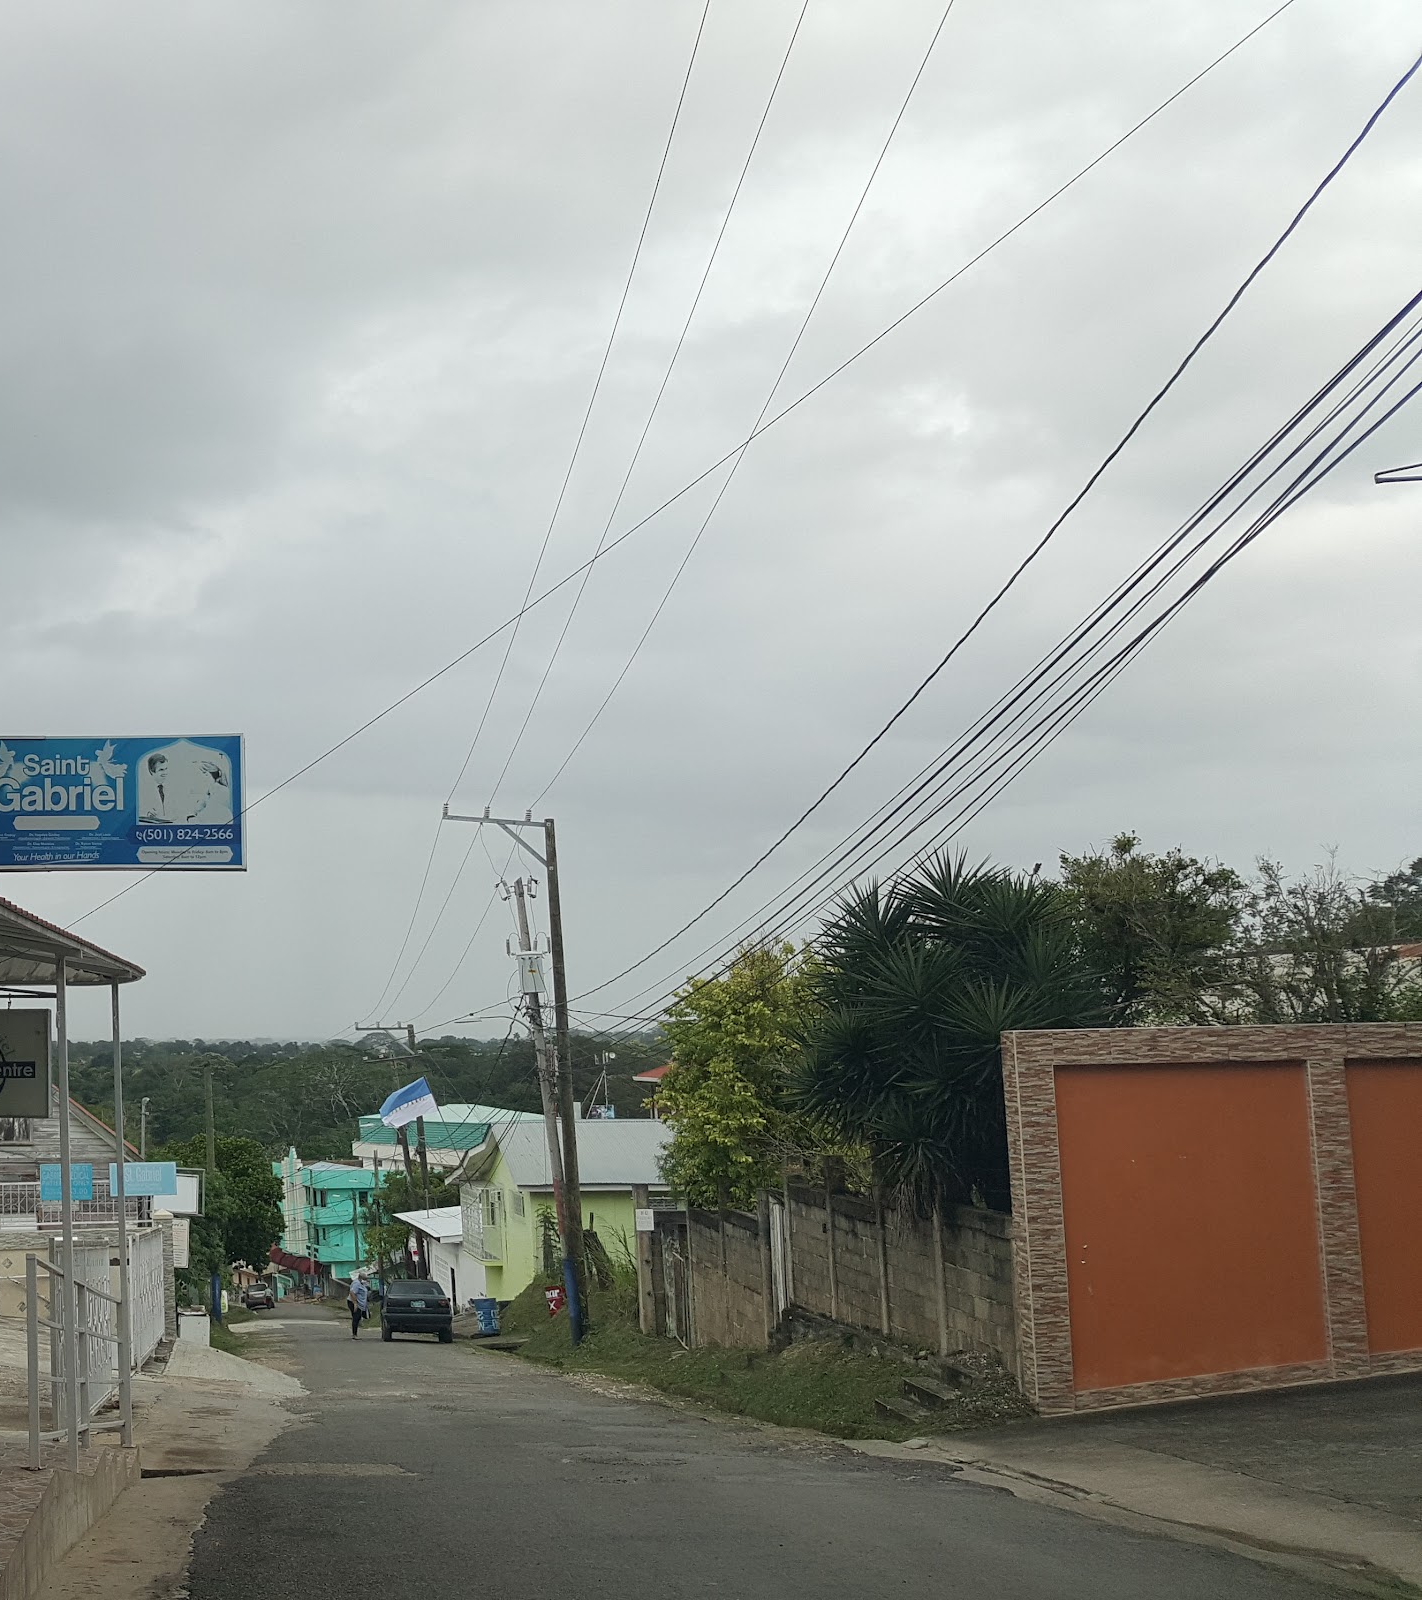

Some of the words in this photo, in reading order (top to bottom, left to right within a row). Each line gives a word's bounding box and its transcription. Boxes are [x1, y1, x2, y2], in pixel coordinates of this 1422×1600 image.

[22, 753, 90, 777] Saint
[142, 829, 173, 843] (501)
[177, 829, 233, 840] 824-2566
[13, 853, 29, 862] Your
[30, 853, 53, 861] Health
[77, 851, 100, 860] Hands
[136, 1166, 162, 1182] Gabriel
